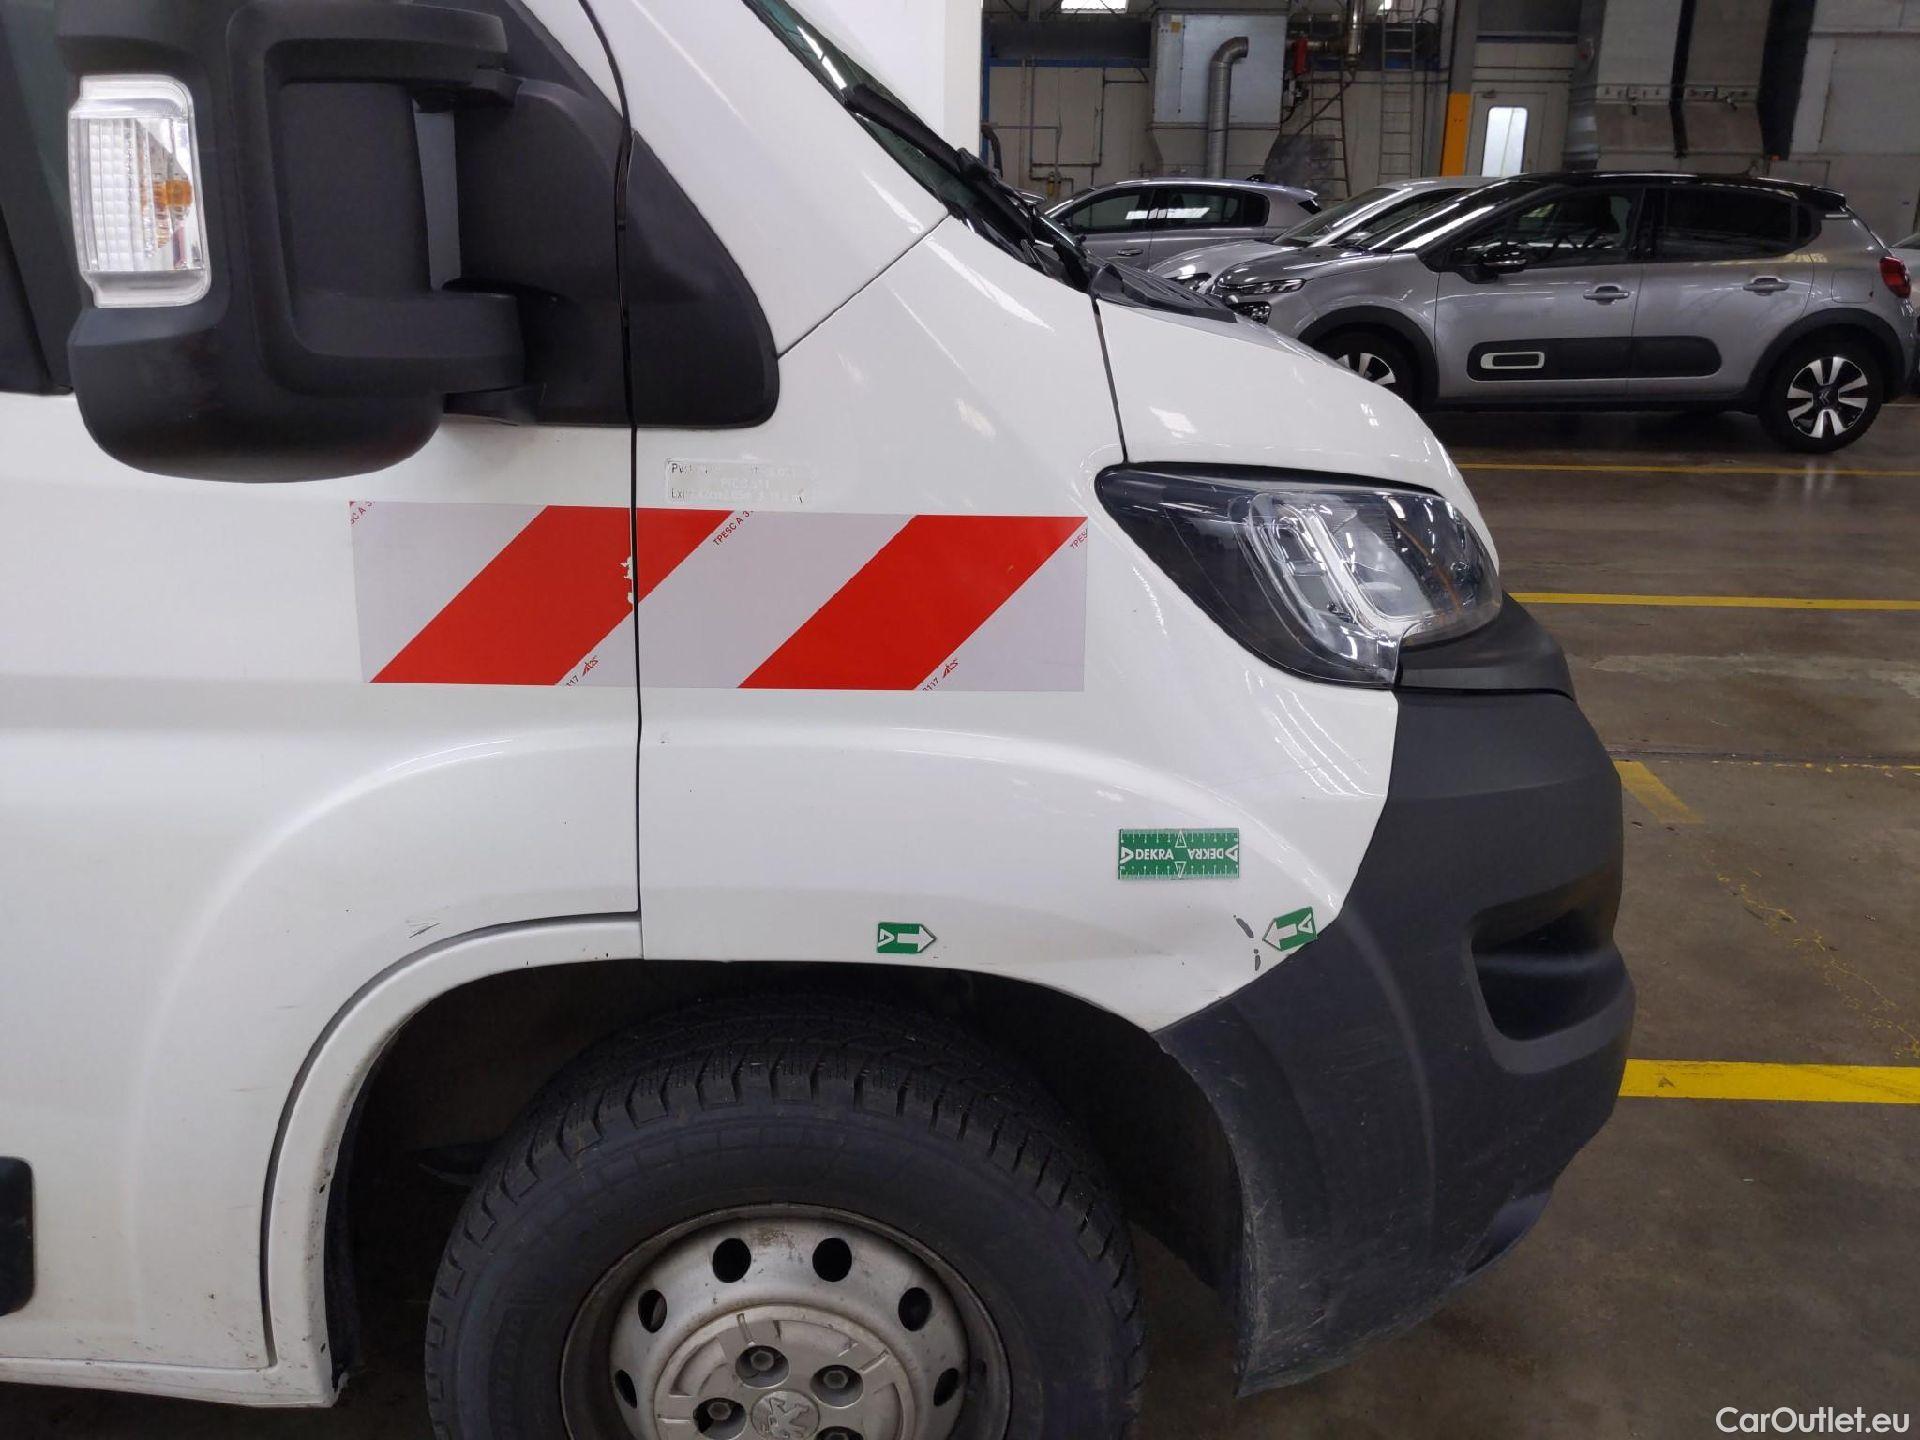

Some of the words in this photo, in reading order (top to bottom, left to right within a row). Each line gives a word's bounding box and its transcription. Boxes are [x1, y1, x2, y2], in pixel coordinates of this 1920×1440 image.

[736, 517, 744, 525] A
[1135, 848, 1174, 860] DEKRA
[1187, 847, 1224, 860] DEKRA
